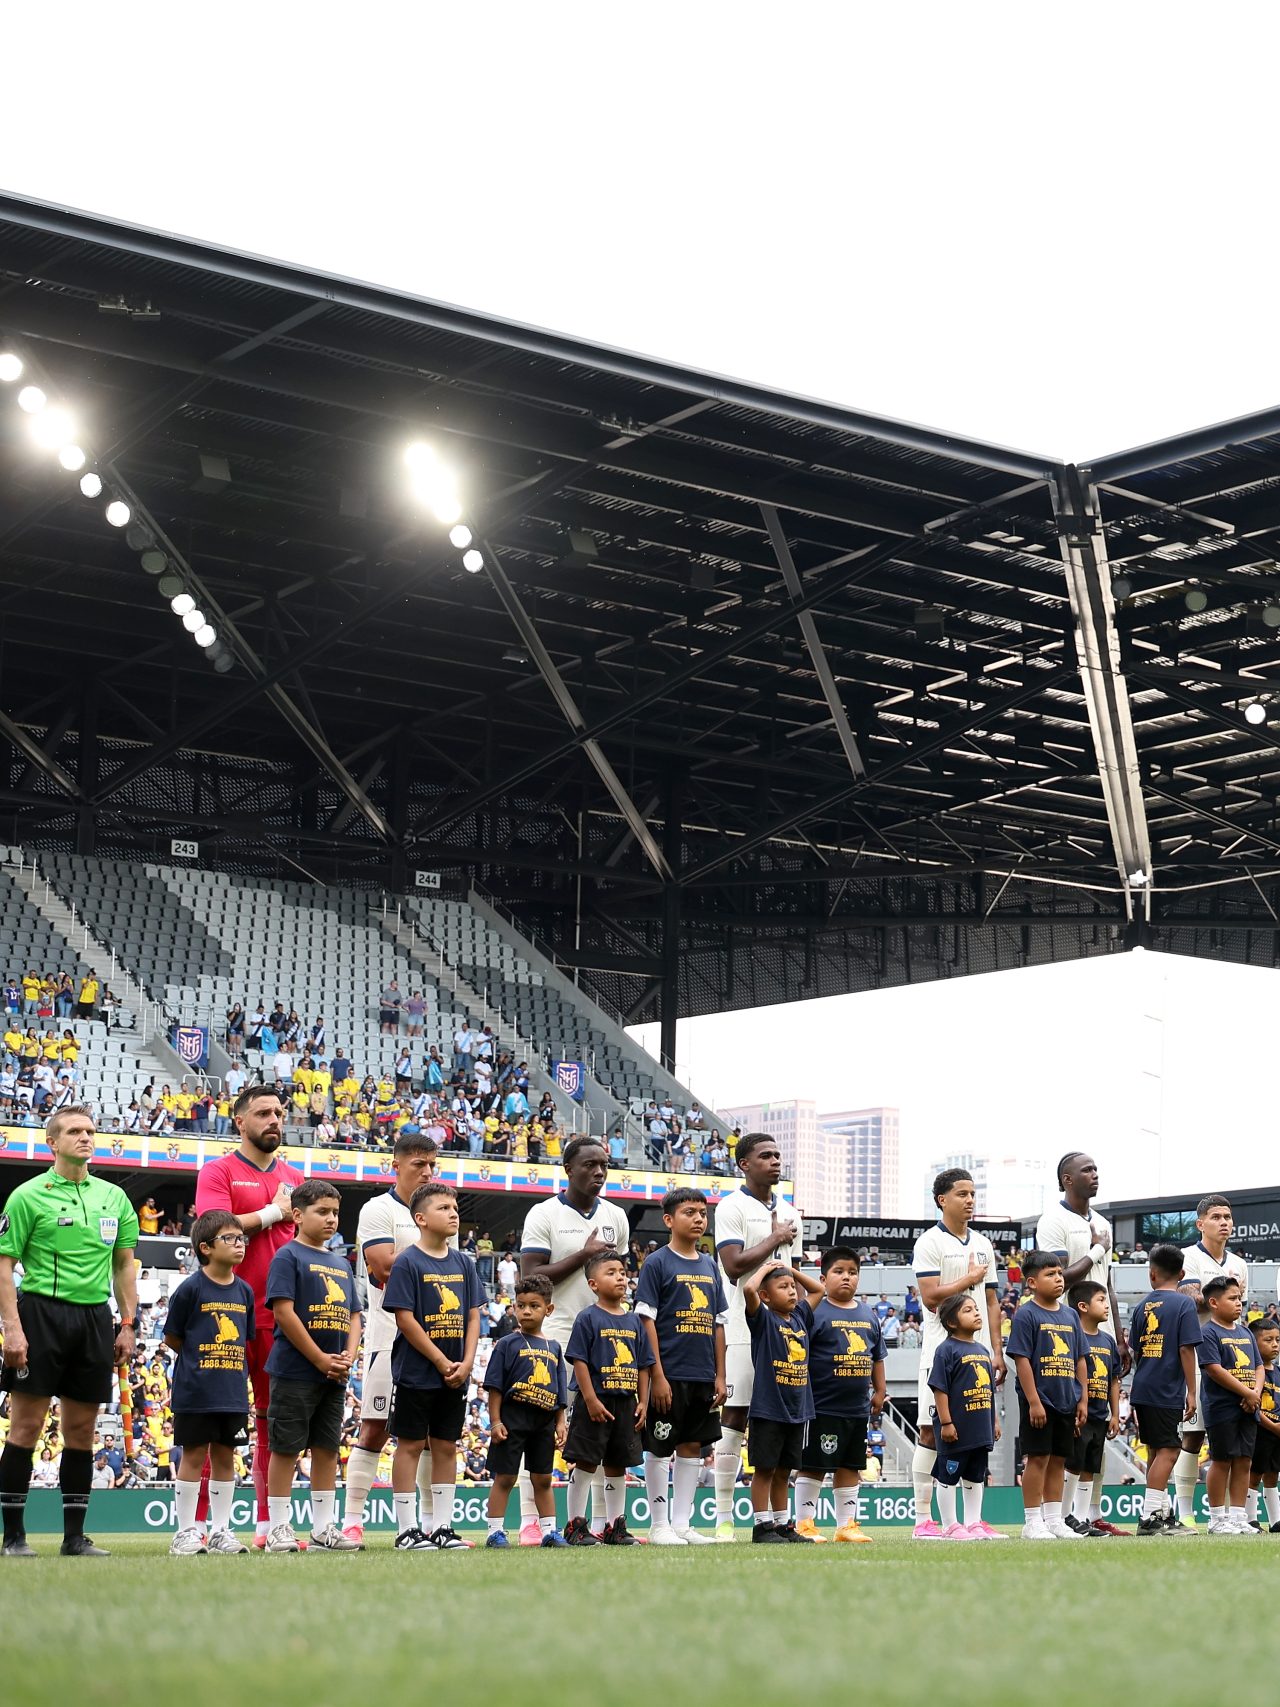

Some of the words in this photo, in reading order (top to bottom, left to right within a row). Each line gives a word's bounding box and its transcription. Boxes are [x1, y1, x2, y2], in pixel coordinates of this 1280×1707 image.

[174, 842, 196, 855] 243
[418, 874, 437, 885] 244
[102, 1219, 117, 1227] FIFA
[802, 1219, 829, 1241] EP
[840, 1226, 910, 1239] AMERICAN
[199, 1359, 244, 1371] 1.888.388.15
[602, 1379, 638, 1391] 1.888.388.15
